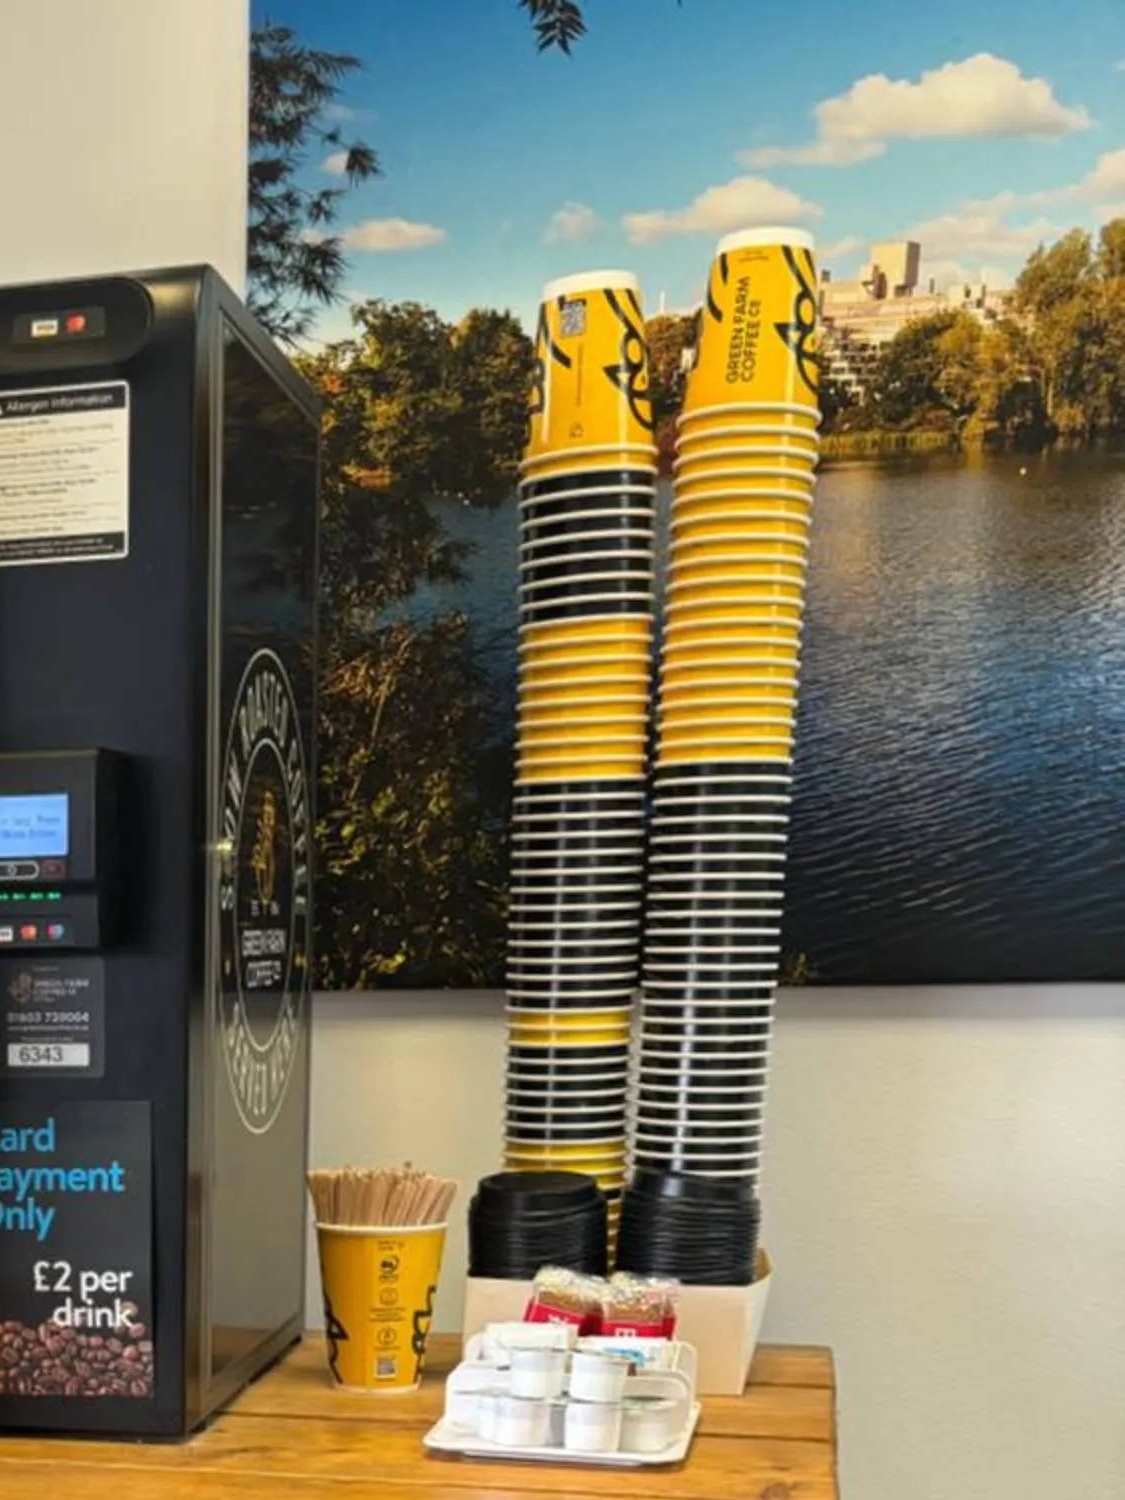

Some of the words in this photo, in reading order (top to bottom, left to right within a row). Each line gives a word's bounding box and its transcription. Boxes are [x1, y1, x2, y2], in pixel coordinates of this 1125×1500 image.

[732, 276, 750, 324] FARM
[725, 326, 744, 384] GREEN
[740, 319, 761, 382] COFFEE
[19, 1046, 63, 1063] 6343
[32, 1260, 74, 1293] £2
[79, 1268, 134, 1301] per
[52, 1297, 134, 1329] drink
